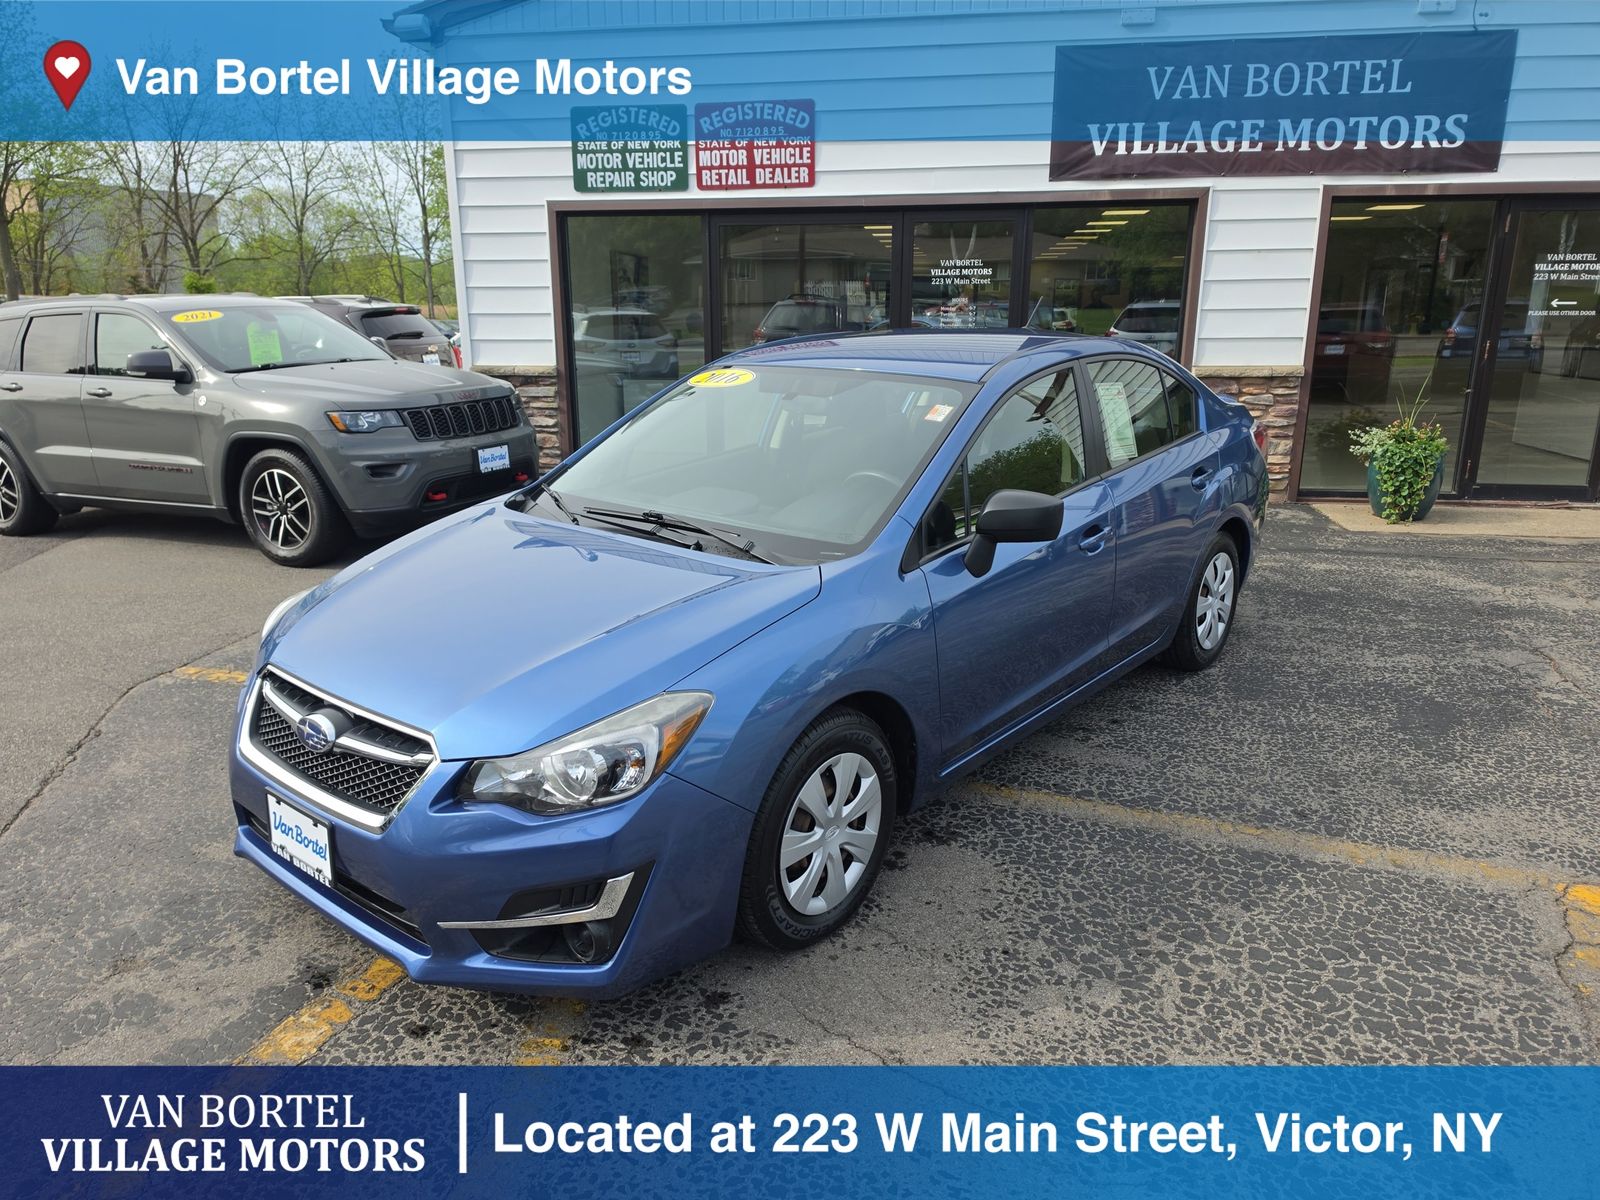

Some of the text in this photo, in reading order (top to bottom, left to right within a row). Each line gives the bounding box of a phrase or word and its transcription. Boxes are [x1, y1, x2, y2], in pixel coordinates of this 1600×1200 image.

[1147, 58, 1413, 100] VAN BORTEL
[575, 106, 681, 139] REGISTERED
[700, 102, 811, 134] REGISTERED
[612, 130, 662, 139] 7120895
[736, 126, 785, 137] 7120895
[1087, 113, 1469, 156] VILLAGE MOTORS
[577, 140, 681, 150] STATE OF NEW YORK
[698, 136, 811, 148] STATE OF NEW YORK
[577, 151, 684, 169] MOTOR VEHICLE
[699, 147, 812, 167] MOTOR VEHICLE
[587, 171, 677, 188] REPAIR SHOP
[702, 167, 809, 186] RETAIL DEALER
[1547, 253, 1598, 261] VAN BORTEL
[940, 259, 984, 267] VAN BORTEL
[1535, 263, 1570, 271] VILLAGE
[931, 268, 961, 276] VILLAGE
[1534, 273, 1549, 281] 223
[1550, 273, 1560, 281] W
[931, 277, 991, 285] 223 W Main Street
[183, 311, 214, 321] 2021
[292, 856, 331, 888] BORTEL
